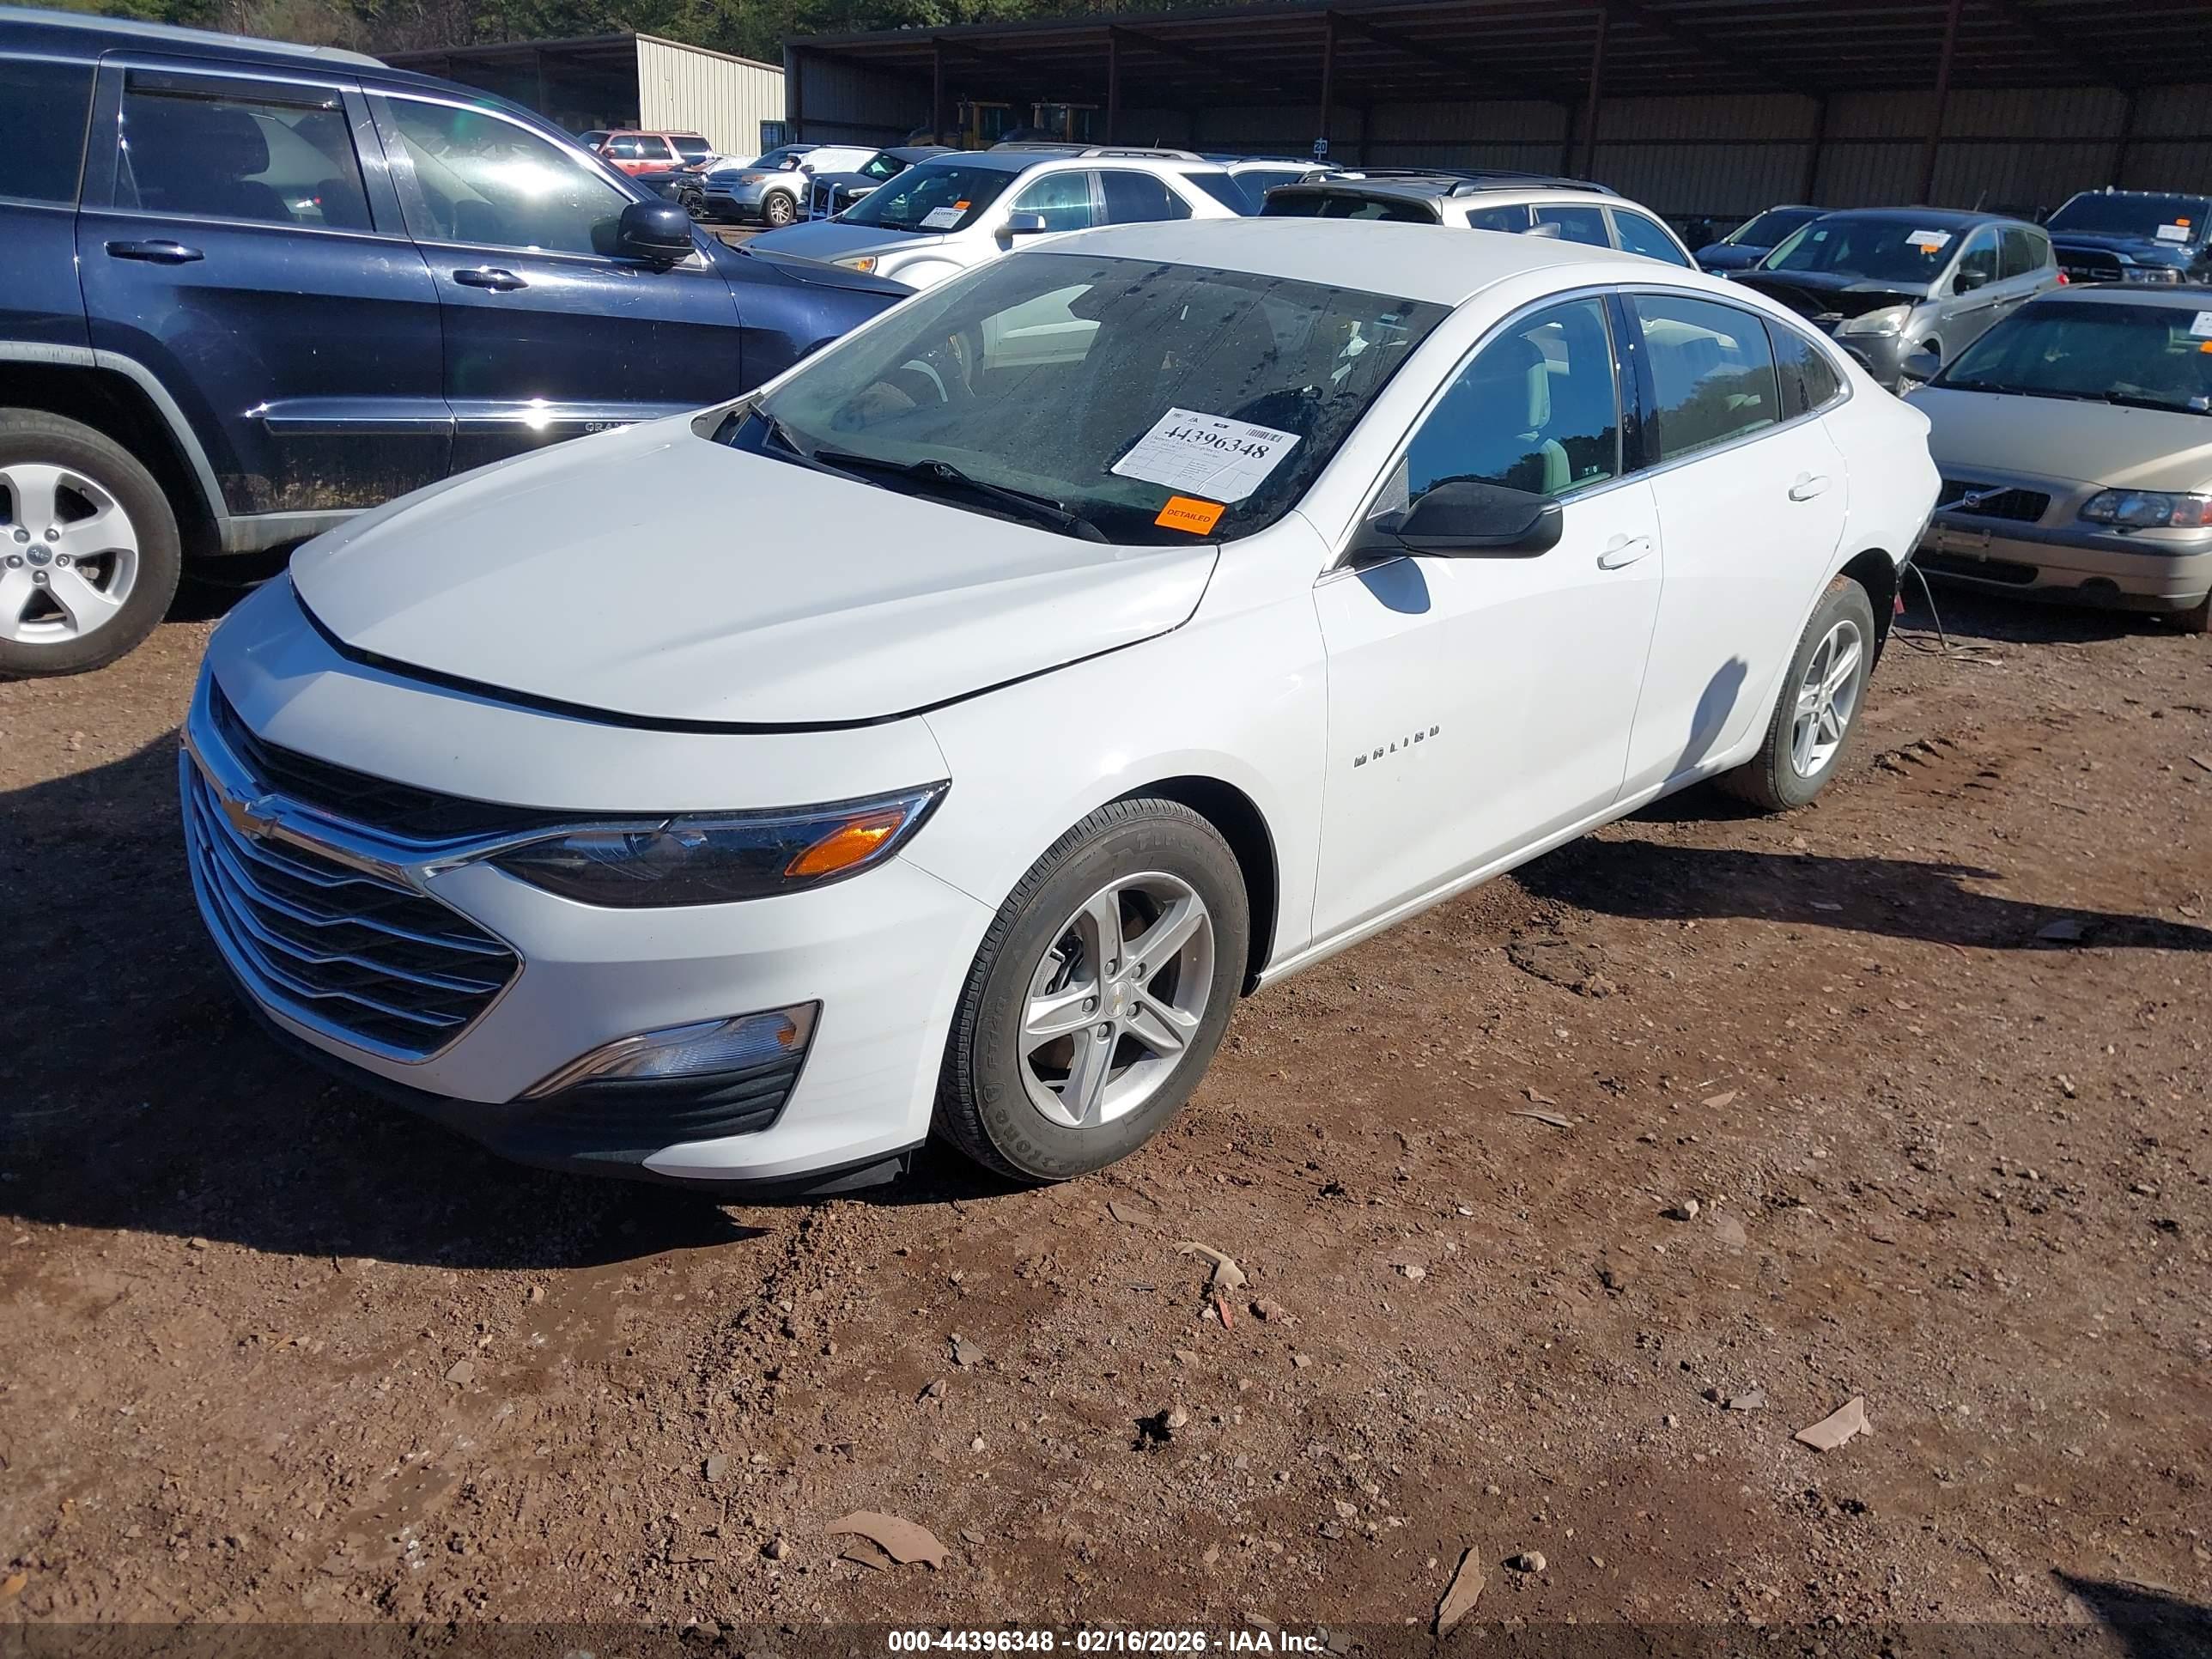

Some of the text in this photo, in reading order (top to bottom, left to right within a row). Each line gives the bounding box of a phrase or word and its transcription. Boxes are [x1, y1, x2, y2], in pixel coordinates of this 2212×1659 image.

[1315, 143, 1327, 152] 20
[585, 422, 631, 432] GRA
[1164, 426, 1270, 459] 44396348
[1166, 507, 1211, 523] DETAILED
[1354, 725, 1439, 768] MALIBU
